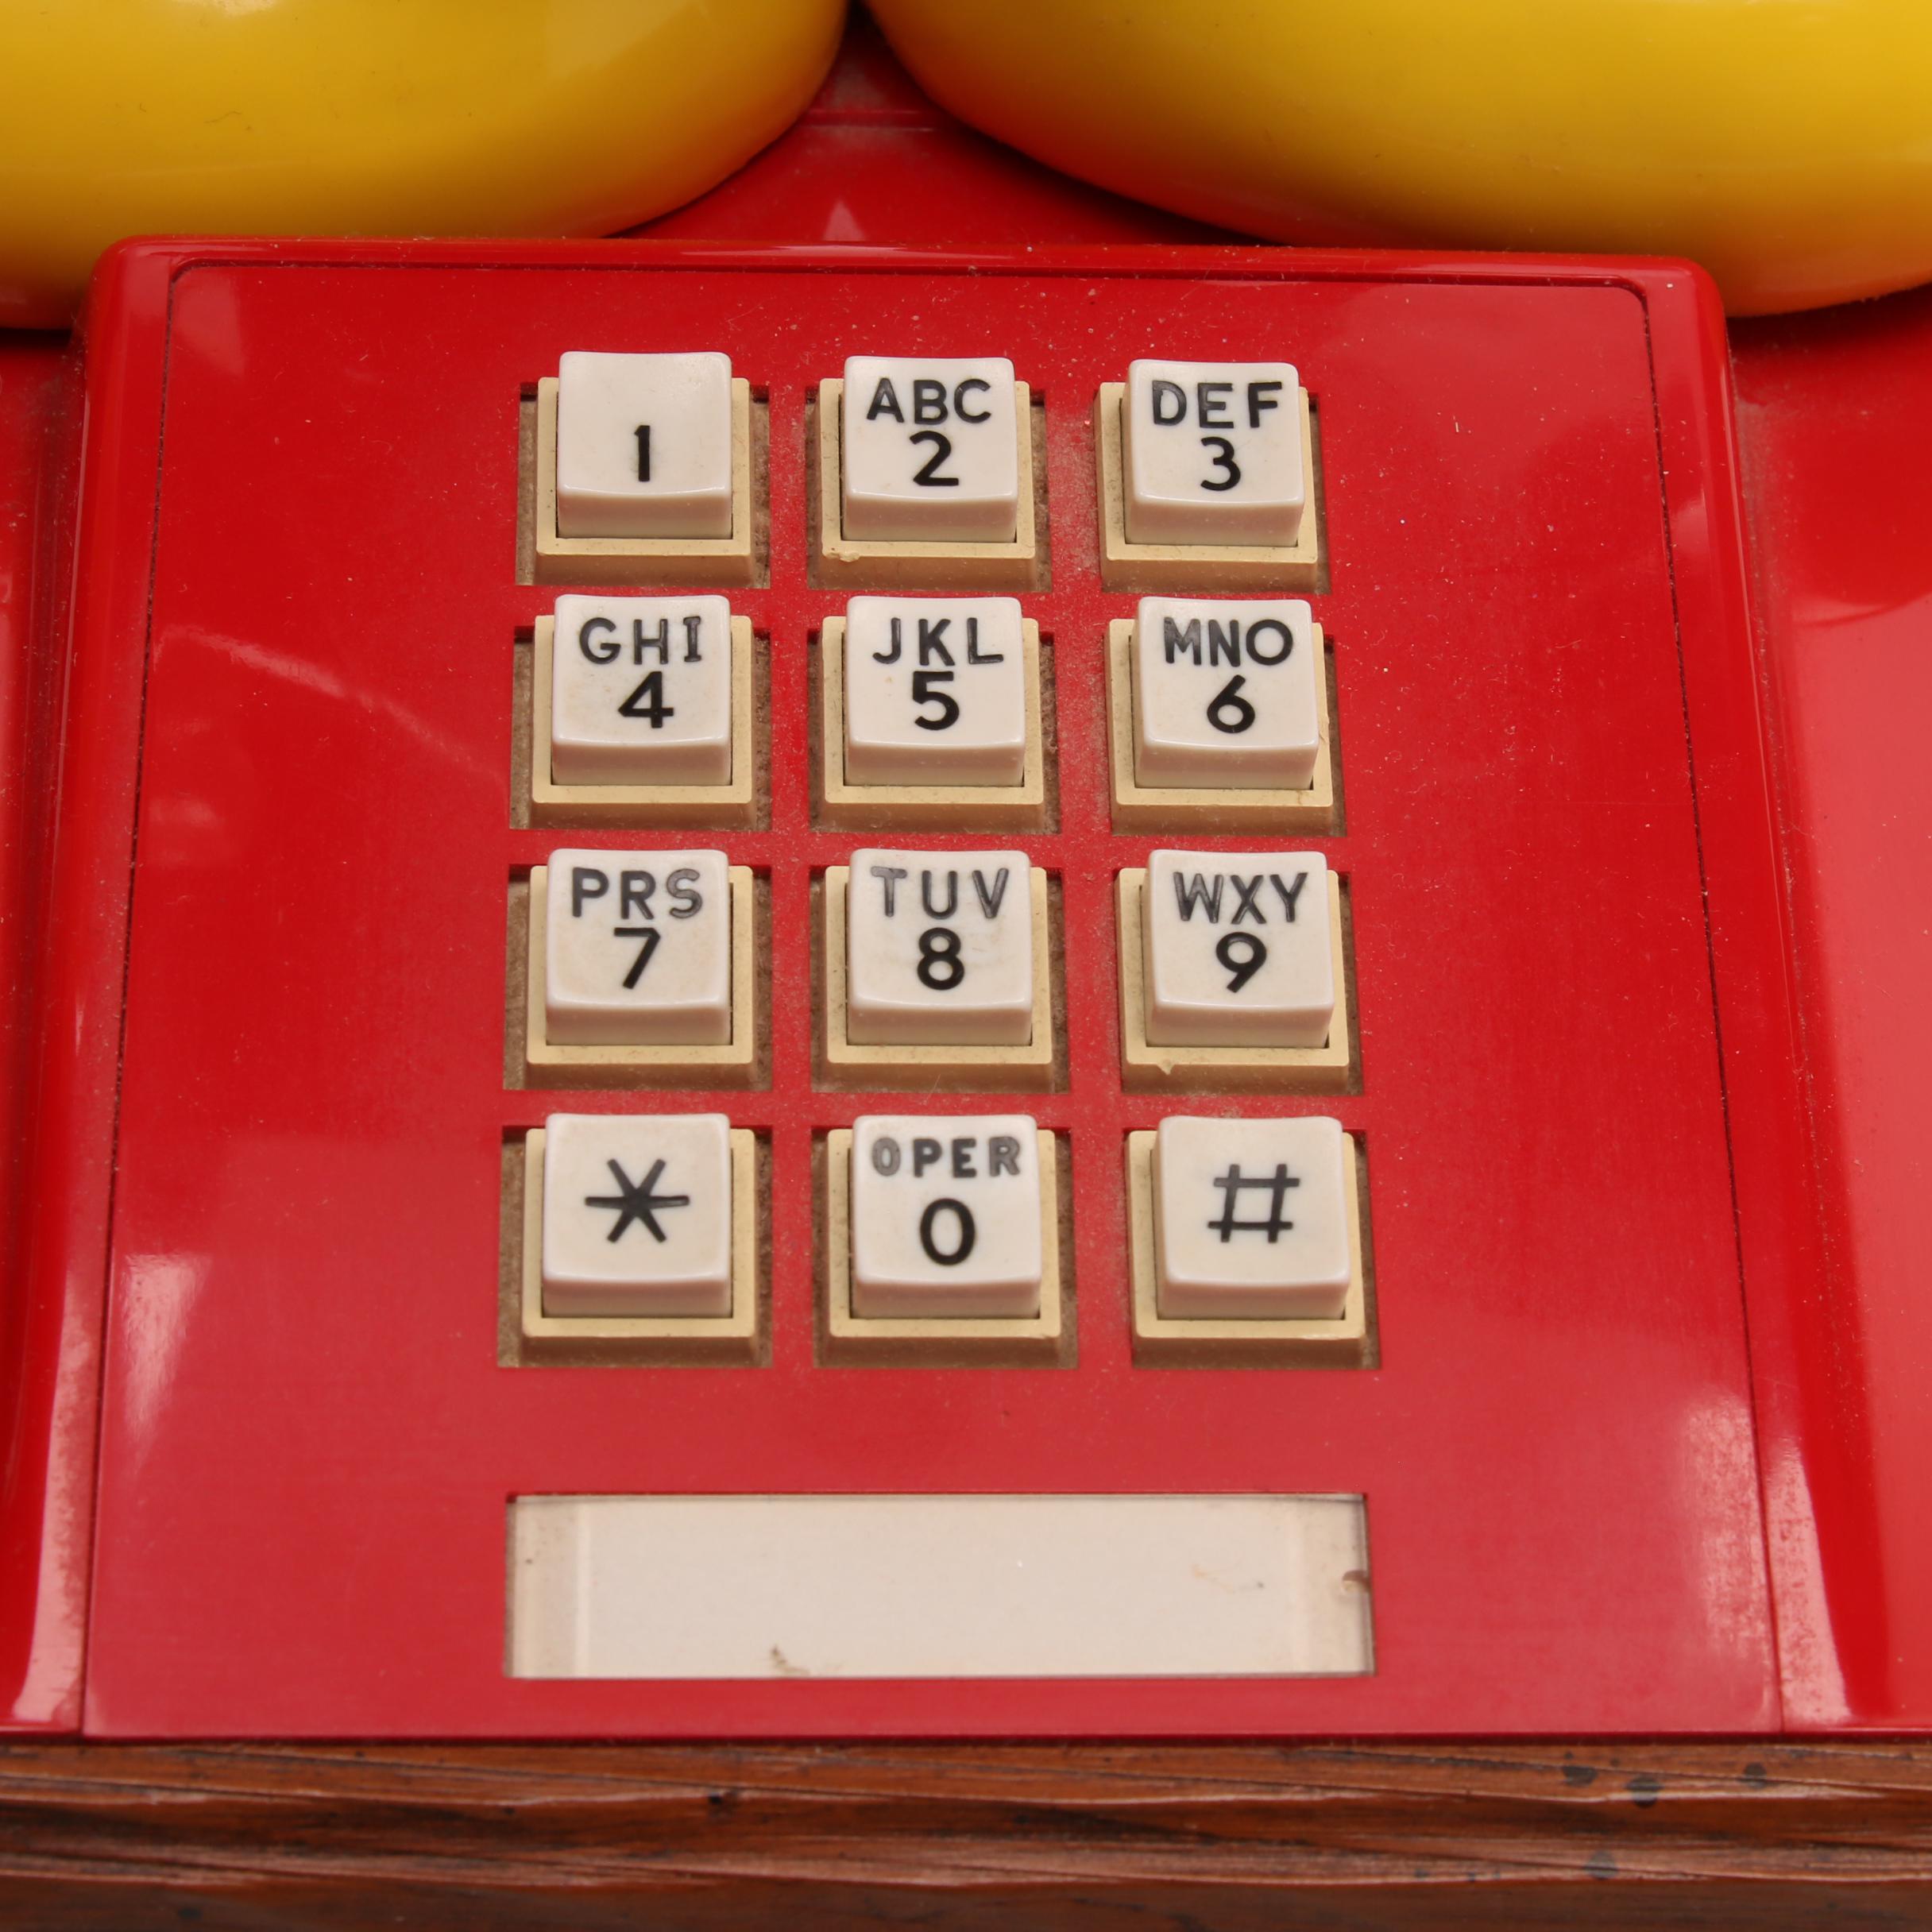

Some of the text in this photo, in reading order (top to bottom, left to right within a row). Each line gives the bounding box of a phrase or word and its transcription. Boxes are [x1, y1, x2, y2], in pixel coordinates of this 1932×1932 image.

[866, 377, 992, 426] ABC
[1152, 380, 1283, 430] DEF
[633, 424, 651, 483] 1
[909, 430, 960, 487] 2
[1200, 435, 1242, 492] 3
[578, 615, 702, 666] GHI
[872, 616, 1004, 667] JKL
[1163, 616, 1294, 668] MNO
[617, 670, 674, 729] 4
[911, 670, 960, 732] 5
[1206, 674, 1256, 734] 6
[572, 867, 703, 921] PRS
[871, 867, 1010, 921] TUV
[1173, 871, 1308, 925] WXY
[613, 926, 662, 990] 7
[916, 926, 965, 990] 8
[1215, 932, 1268, 994] 9
[872, 1136, 1020, 1179] OPER
[918, 1197, 977, 1267] 0
